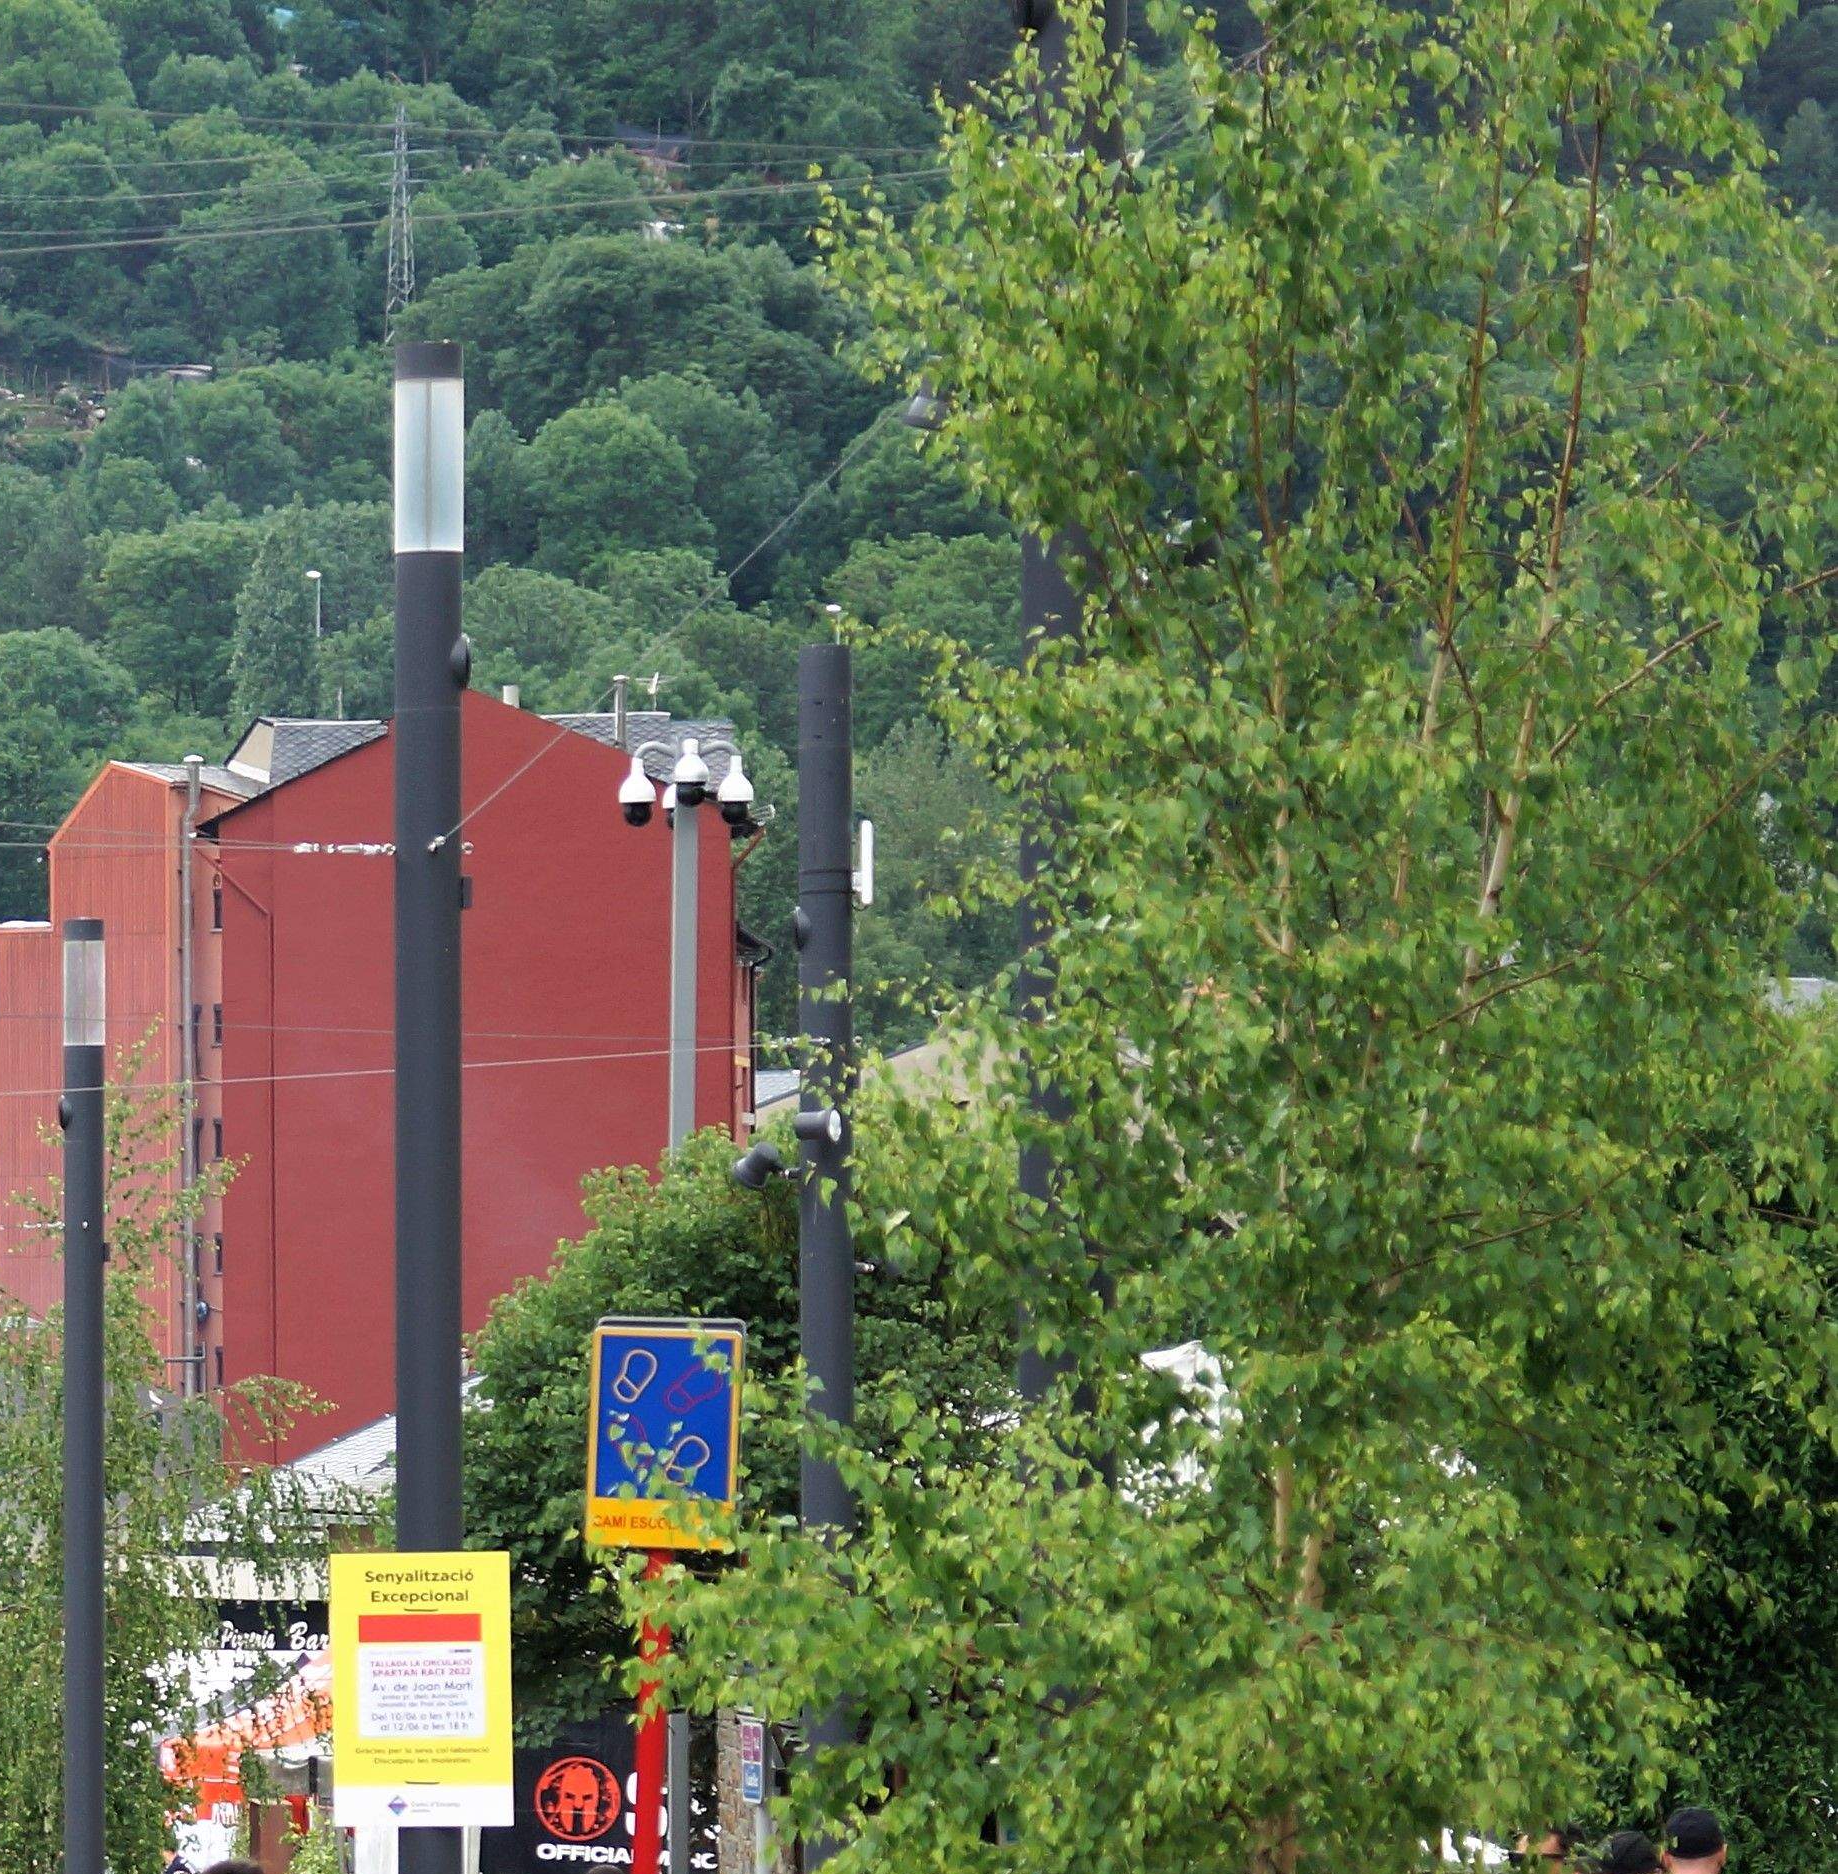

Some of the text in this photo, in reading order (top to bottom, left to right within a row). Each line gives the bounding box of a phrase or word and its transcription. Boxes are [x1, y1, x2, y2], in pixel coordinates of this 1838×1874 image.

[364, 1568, 474, 1585] Senyalització
[370, 1589, 470, 1604] Excepcional
[535, 1842, 634, 1864] OFFICIA
